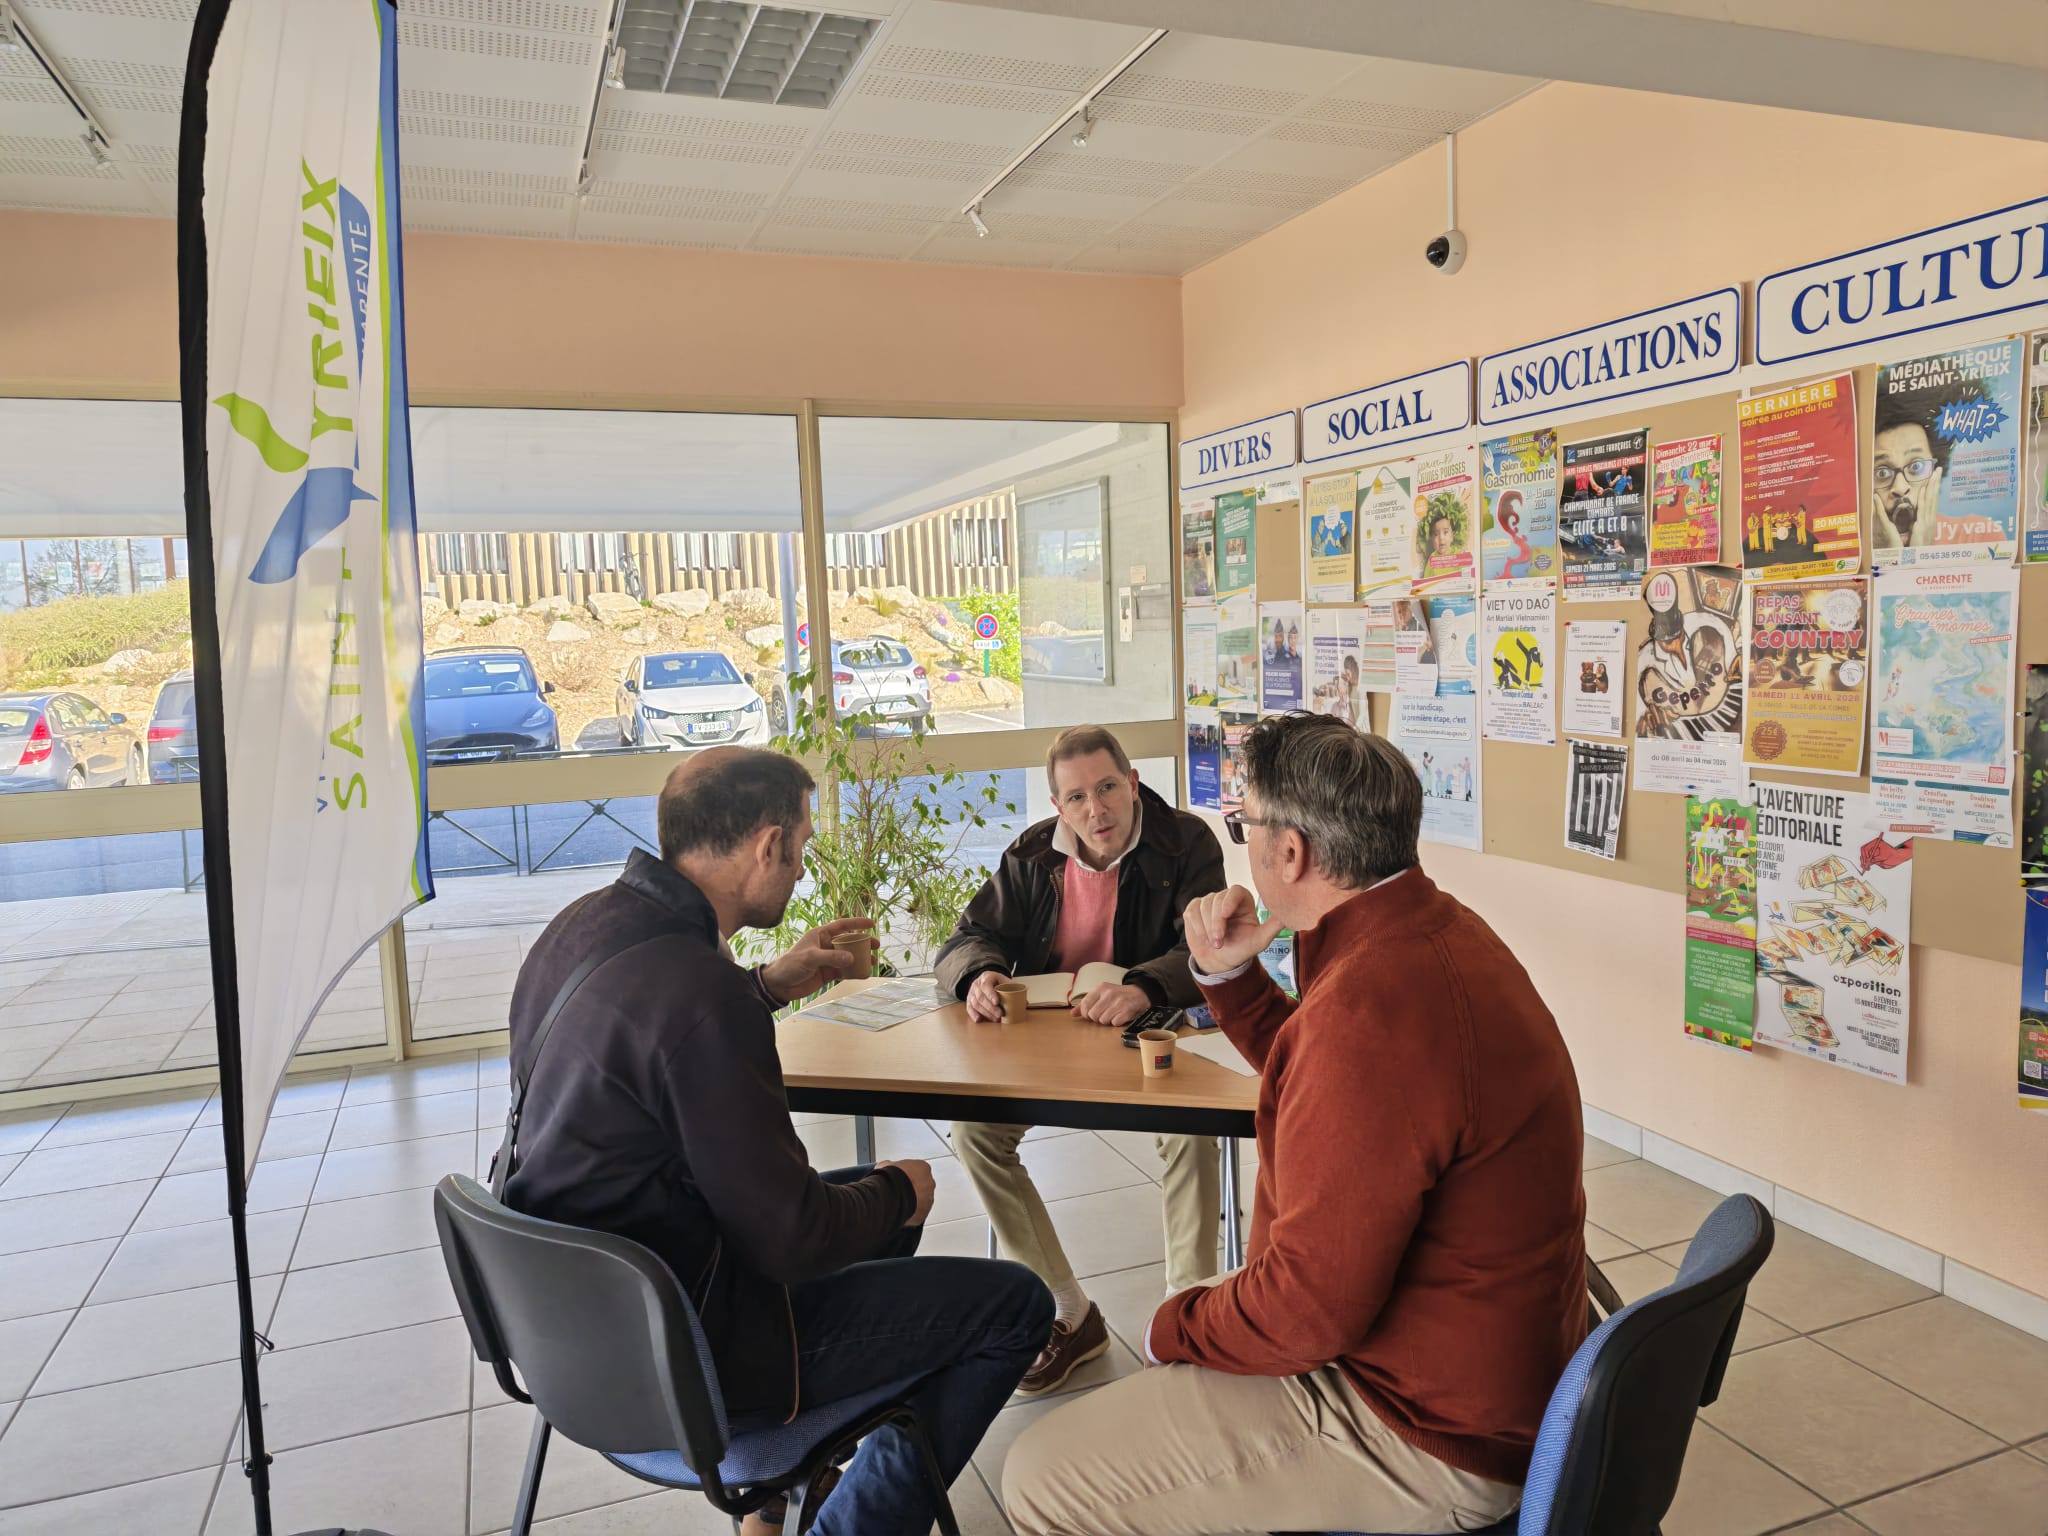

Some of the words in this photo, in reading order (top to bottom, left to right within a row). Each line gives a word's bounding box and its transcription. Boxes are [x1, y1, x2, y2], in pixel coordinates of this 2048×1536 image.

[1491, 311, 1723, 409] ASSOCIATIONS
[1889, 345, 2011, 381] MÉDIATHÈQUE
[1888, 381, 1906, 395] DE
[1909, 361, 2010, 391] SAINT-YRIEIX
[1327, 390, 1433, 445] SOCIAL
[1771, 412, 1783, 422] au
[1784, 407, 1803, 418] coin
[1805, 402, 1816, 413] du
[1199, 431, 1272, 477] DIVERS
[1656, 445, 1686, 459] Dimanche
[1687, 440, 1698, 452] 22
[1440, 461, 1466, 478] POUSSES
[1501, 459, 1519, 472] Salon
[1519, 460, 1528, 470] de
[1485, 465, 1556, 489] Gastronomie
[1563, 499, 1606, 513] CHAMPIONNAT
[1606, 497, 1614, 507] DE
[1615, 493, 1640, 505] FRANCE
[1572, 518, 1596, 536] ELITE
[1597, 518, 1605, 533] A
[1607, 516, 1618, 532] ET
[1828, 515, 1857, 527] MARS
[1962, 517, 2003, 535] vais
[1919, 552, 1930, 560] 05
[1961, 550, 1972, 559] 00
[1565, 564, 1583, 574] SAMEDI
[1583, 563, 1589, 572] 21
[1589, 561, 1604, 572] MARS
[1916, 573, 1973, 585] CHARENTE
[1486, 600, 1506, 611] VIET
[1508, 599, 1523, 611] VO
[1526, 598, 1550, 610] DAO
[1756, 595, 1800, 609] REPAS
[1756, 611, 1821, 626] DANSANT
[1754, 629, 1864, 649] COUNTRY
[1751, 690, 1786, 699] SAMEDI
[1803, 693, 1833, 701] AVRIL
[1406, 714, 1432, 724] première
[1452, 716, 1467, 724] c'est
[1651, 754, 1660, 762] du
[1756, 787, 1845, 819] L'AVENTURE
[1756, 810, 1843, 847] ÉDITORIALE
[1763, 851, 1776, 860] ANS
[1776, 853, 1785, 863] AU
[1769, 872, 1782, 881] ART
[1861, 999, 1888, 1012] NOVEMBRE
